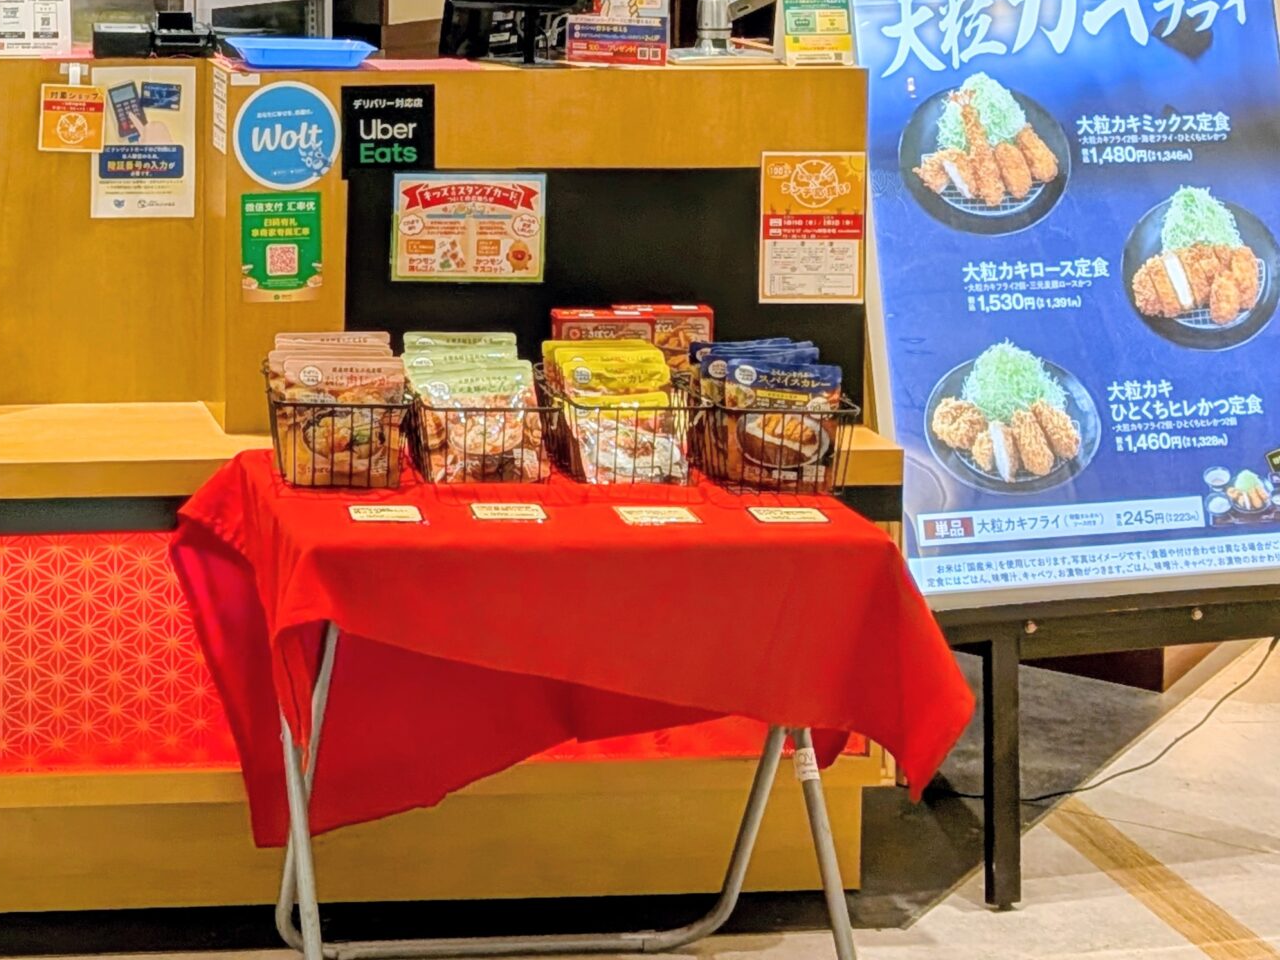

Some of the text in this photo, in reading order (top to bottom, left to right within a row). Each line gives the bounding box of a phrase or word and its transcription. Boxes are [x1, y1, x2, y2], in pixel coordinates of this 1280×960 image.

[352, 97, 424, 109] デリバリー対応店
[359, 118, 418, 140] Uber
[1076, 111, 1231, 135] 大粒カキミックス定食
[251, 121, 324, 153] Wolt
[359, 142, 418, 163] Eats
[245, 202, 284, 213] 微信支付
[962, 257, 1110, 282] 大粒カキロース定食
[759, 374, 831, 388] スパイスカレー
[1107, 380, 1174, 402] 大粒カキ
[1110, 394, 1264, 421] ひとくちヒレかつ定食
[935, 519, 965, 538] 単品
[977, 514, 1061, 534] 大粒カキフライ
